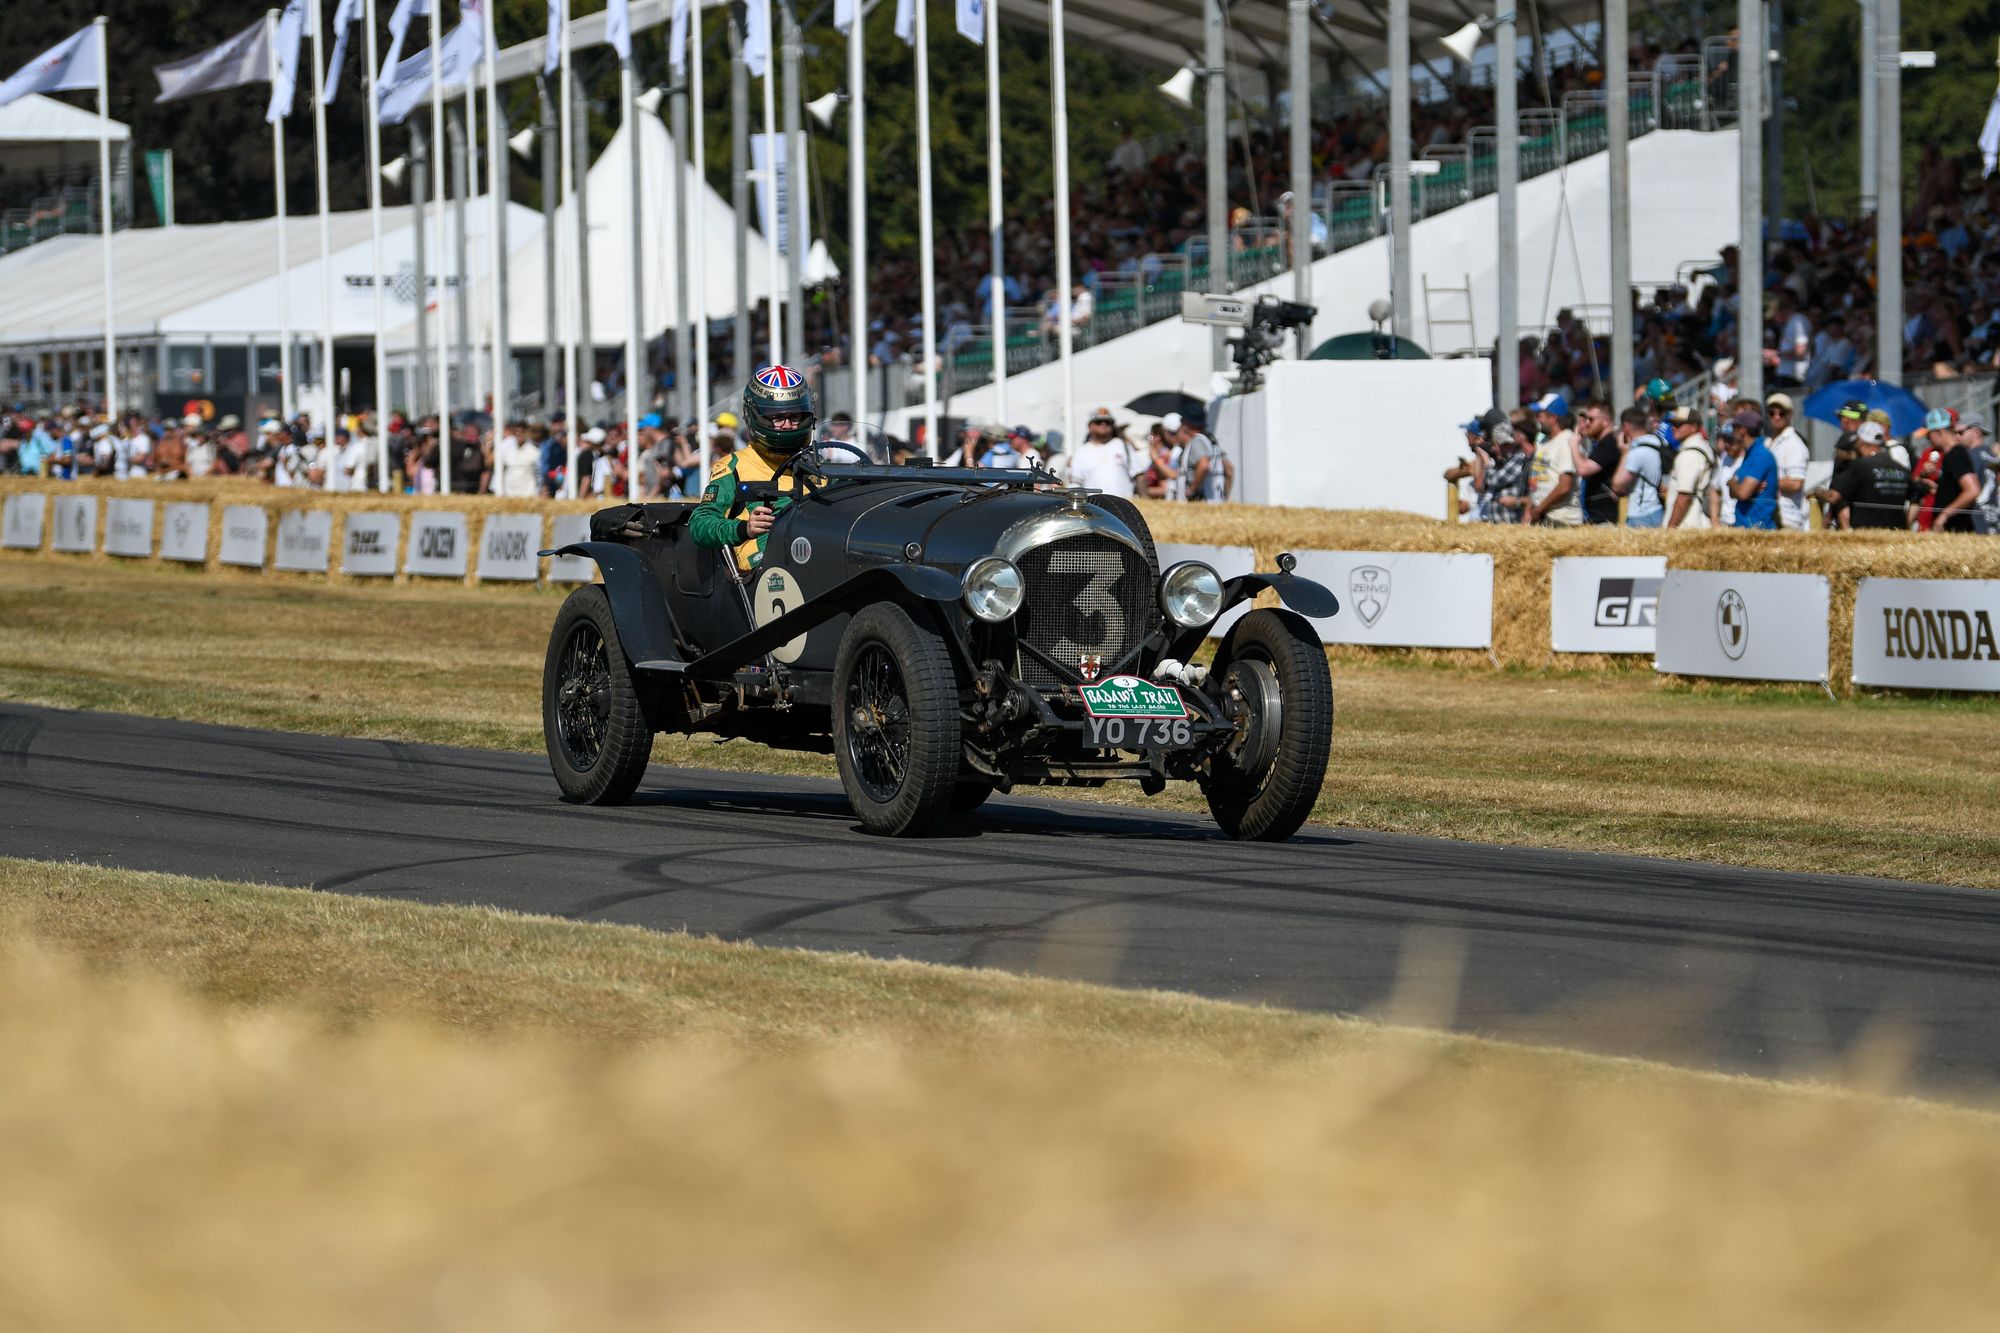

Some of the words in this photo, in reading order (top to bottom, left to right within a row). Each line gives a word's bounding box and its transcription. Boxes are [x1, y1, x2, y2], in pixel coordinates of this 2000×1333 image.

[1047, 551, 1125, 667] 3
[1883, 607, 2000, 660] HONDA
[1089, 717, 1125, 744] YO
[1134, 719, 1191, 745] 736
